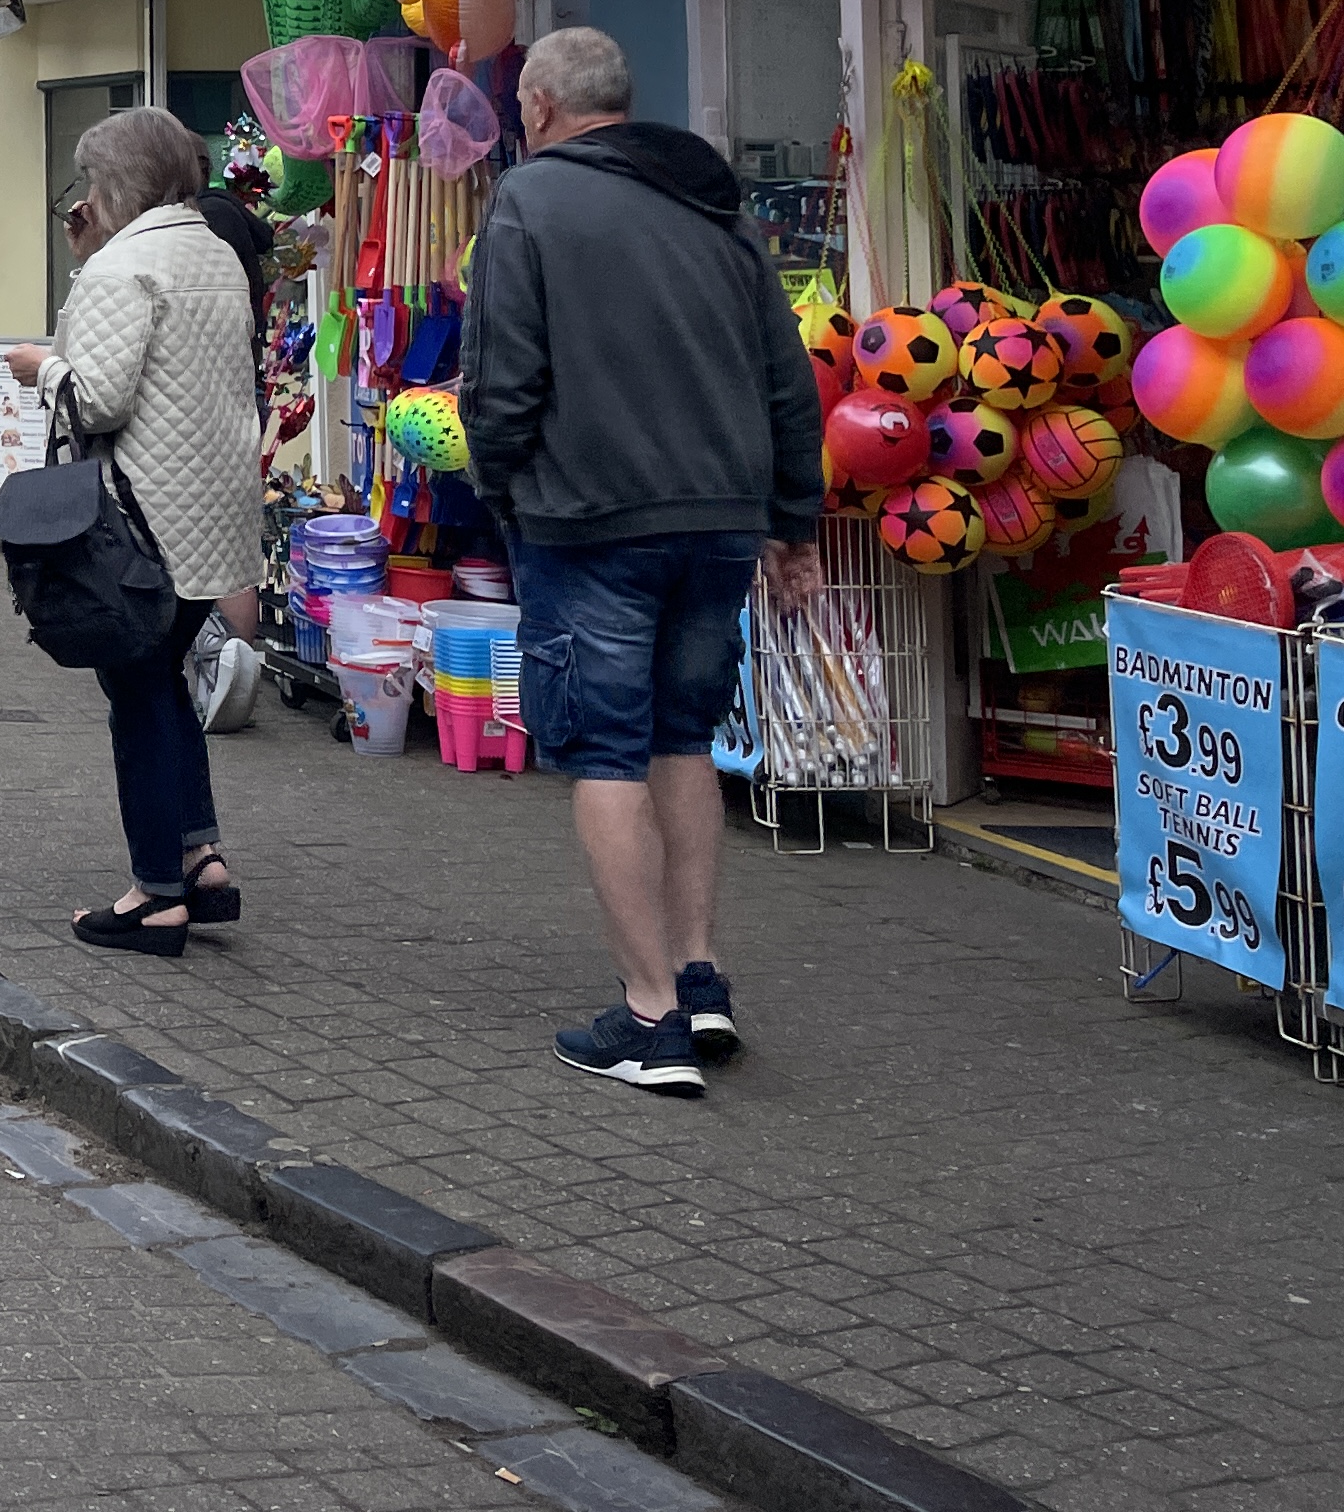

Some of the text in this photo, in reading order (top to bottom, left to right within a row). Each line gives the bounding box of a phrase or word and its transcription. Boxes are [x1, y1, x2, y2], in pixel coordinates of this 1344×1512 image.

[1030, 613, 1107, 647] WAL
[1115, 646, 1272, 710] BADMINTON
[1139, 693, 1242, 785] £3.99
[1138, 773, 1261, 835] SOFT BALL
[1159, 808, 1240, 856] TENNIS
[1147, 841, 1260, 950] £5.99
